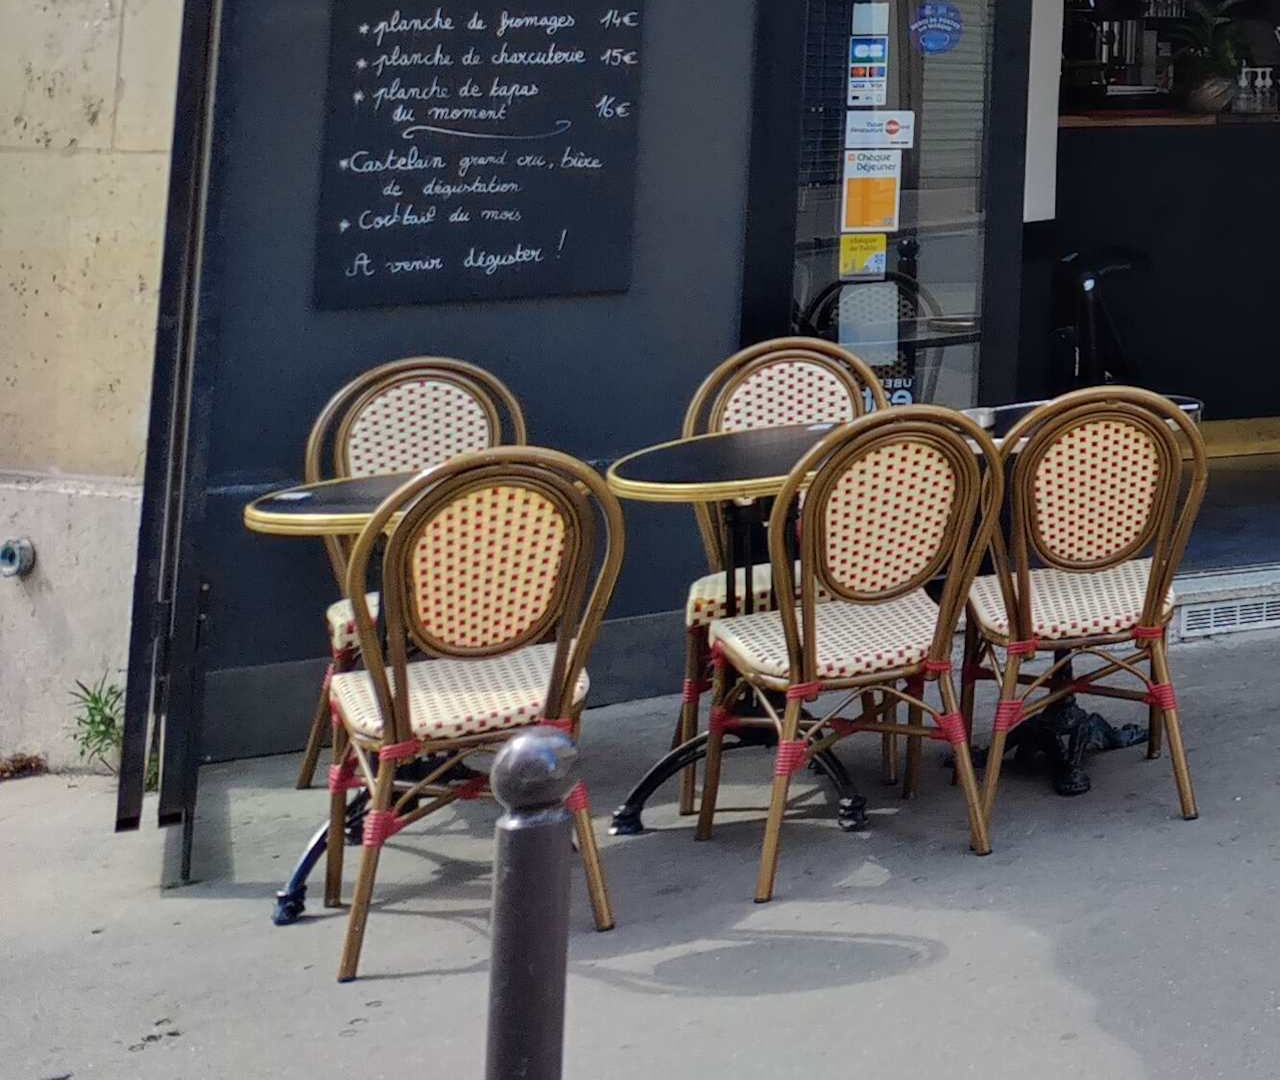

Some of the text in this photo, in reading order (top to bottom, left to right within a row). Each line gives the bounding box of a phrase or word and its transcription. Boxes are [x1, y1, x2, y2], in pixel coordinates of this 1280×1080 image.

[373, 7, 639, 46] planche de fromages 14€
[372, 43, 639, 76] planche de charcuterie 15€
[373, 77, 540, 110] planche de tapas
[392, 94, 632, 122] du moment 16€
[458, 150, 507, 176] grand
[856, 163, 896, 173] Déjeuner
[857, 153, 891, 163] Chèque
[383, 178, 402, 196] de
[449, 206, 470, 222] du
[481, 207, 522, 222] mois
[385, 255, 445, 273] venir
[463, 243, 544, 275] déguster
